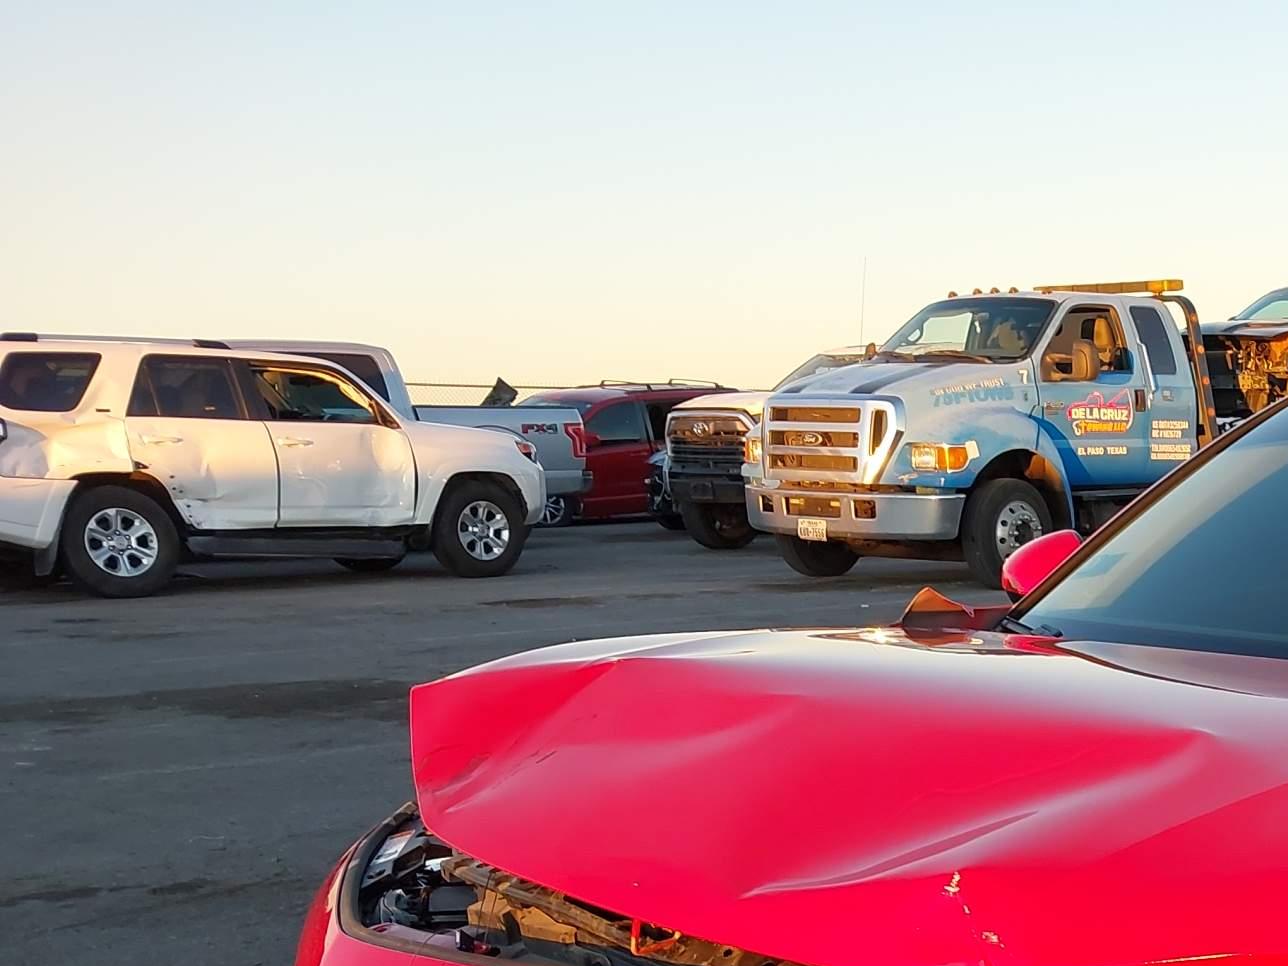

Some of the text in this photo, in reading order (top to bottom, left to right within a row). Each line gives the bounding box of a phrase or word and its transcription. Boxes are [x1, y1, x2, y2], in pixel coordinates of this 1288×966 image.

[1018, 369, 1029, 385] 7
[1071, 408, 1129, 421] DE LA CRUZ
[521, 423, 558, 435] FX4
[1077, 446, 1128, 456] EL PASO TEXAS
